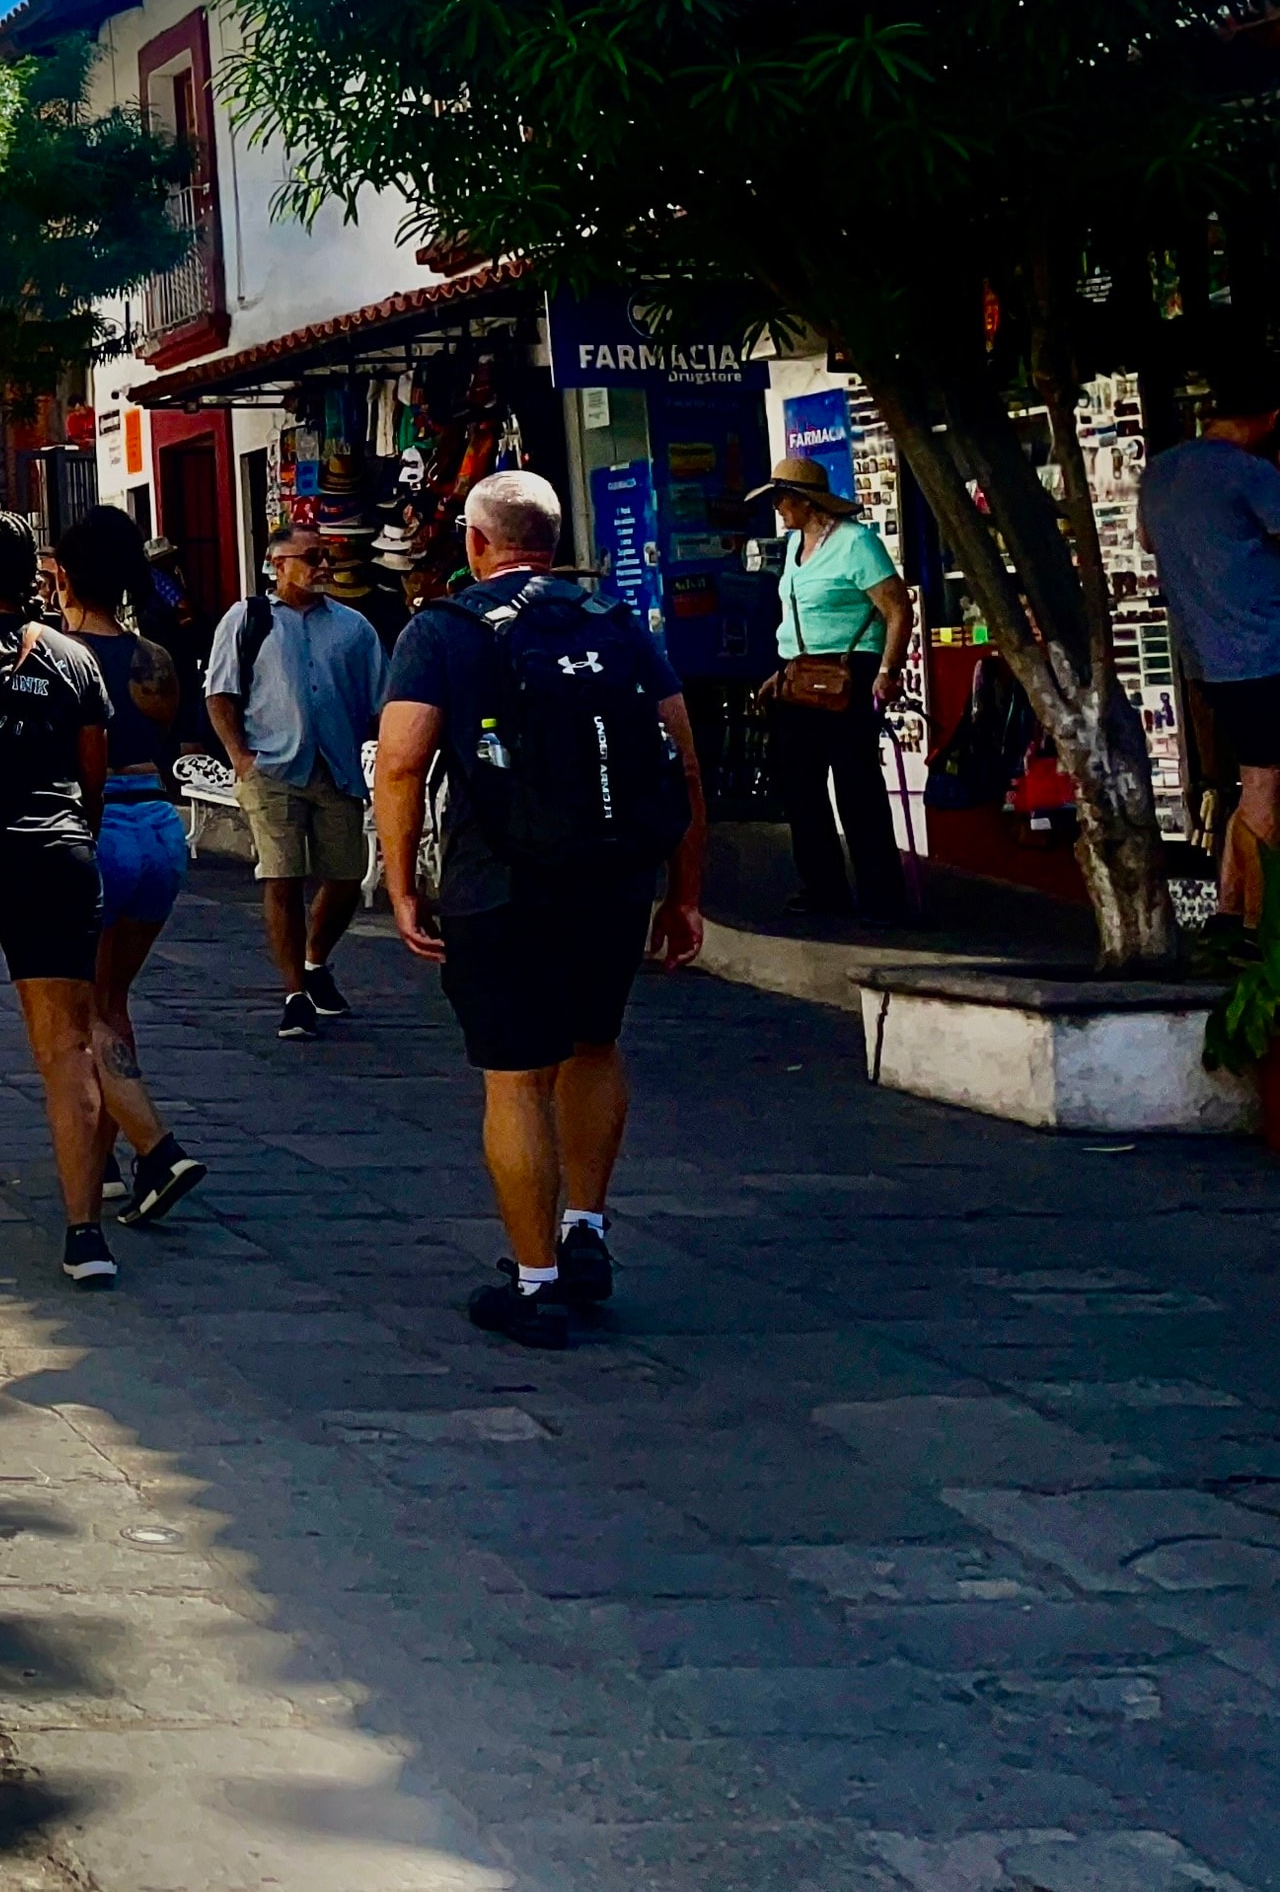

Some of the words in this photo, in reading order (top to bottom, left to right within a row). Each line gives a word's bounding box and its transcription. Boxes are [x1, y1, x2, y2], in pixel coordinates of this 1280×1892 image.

[579, 344, 740, 370] FARMACIA
[668, 370, 742, 385] Drugstore
[789, 426, 847, 448] FARMACIA
